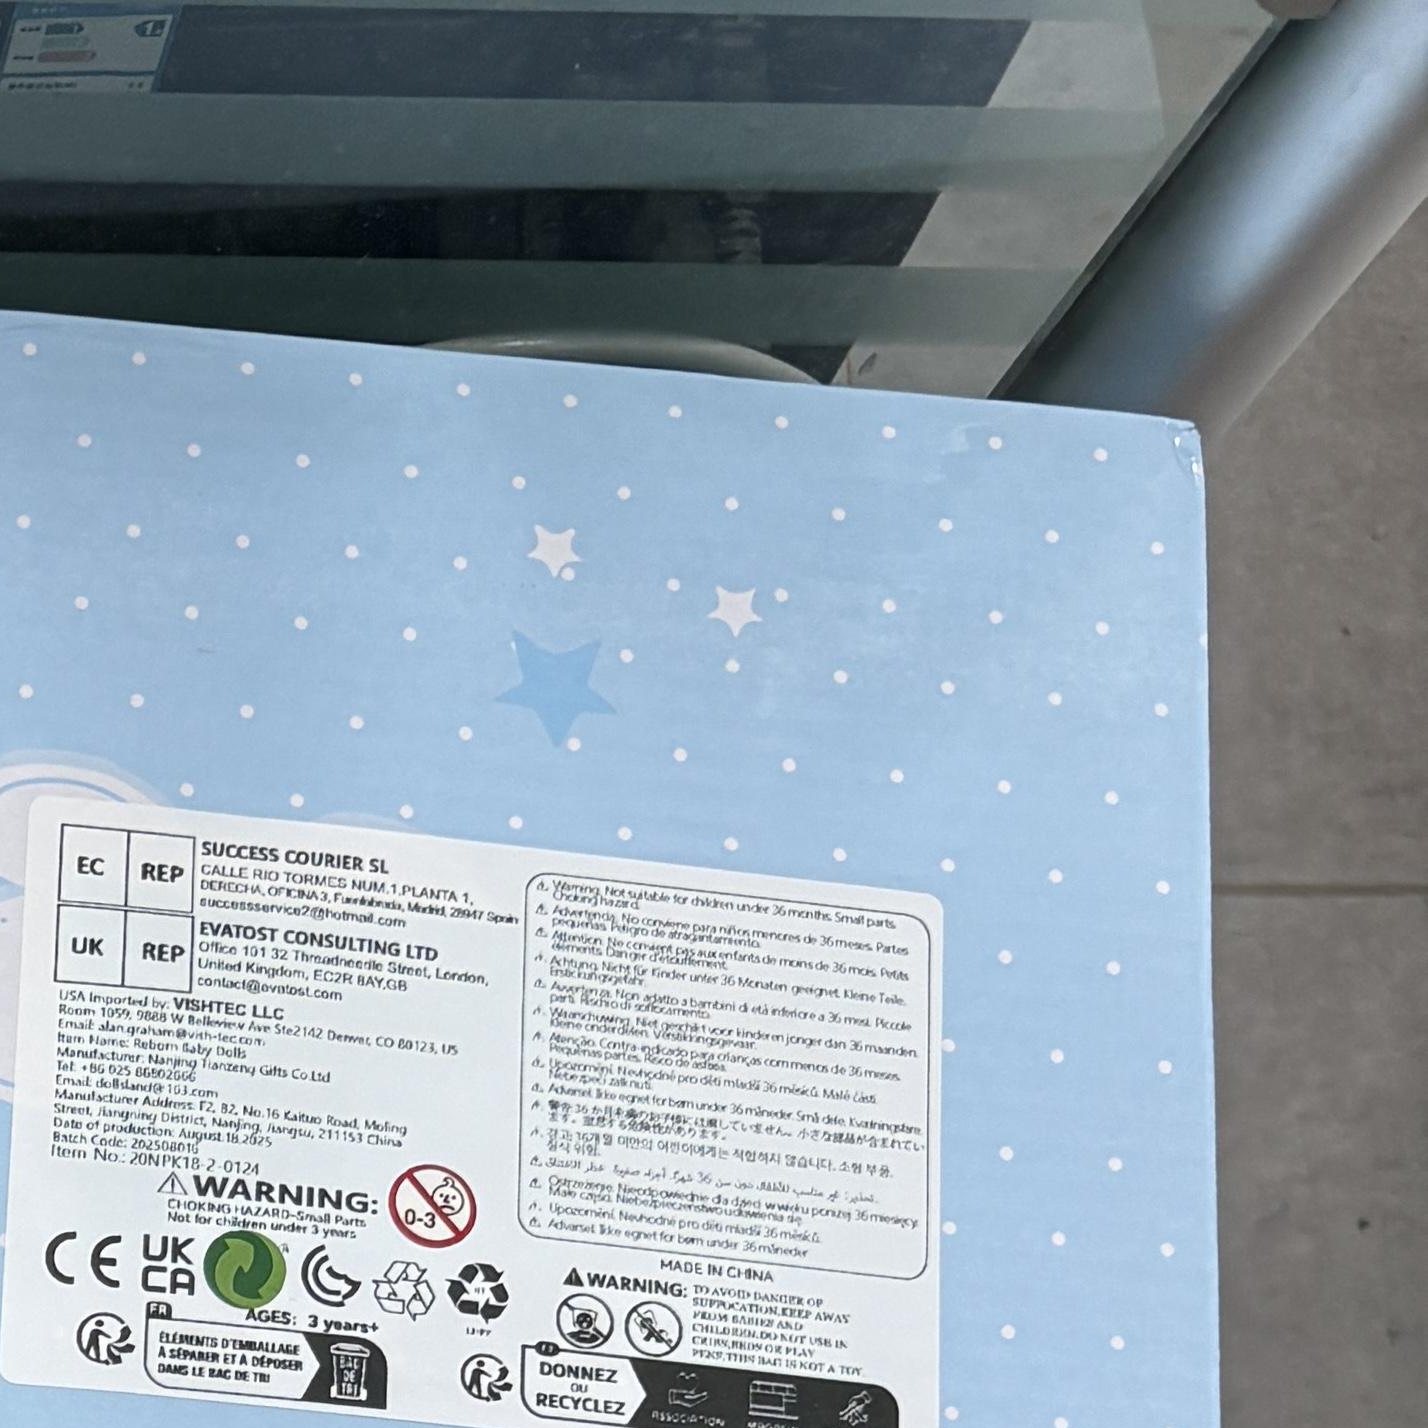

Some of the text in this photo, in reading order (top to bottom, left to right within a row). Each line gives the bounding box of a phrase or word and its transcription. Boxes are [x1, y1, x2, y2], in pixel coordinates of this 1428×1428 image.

[77, 855, 105, 876] EC
[201, 840, 389, 875] SUCCESS COURIER SL
[141, 862, 185, 883] REP
[200, 863, 348, 889] CALLE RIO TORMES
[772, 904, 787, 917] 36
[199, 921, 439, 962] EVATOST CONSULTING LTD
[621, 912, 640, 925] No
[803, 933, 818, 945] de
[820, 935, 834, 947] 36
[71, 936, 104, 957] UK
[142, 941, 186, 963] REP
[242, 945, 266, 958] 101
[271, 947, 288, 961] 32
[197, 957, 242, 973] United
[720, 974, 736, 986] 36
[59, 989, 285, 1021] USA Imported VISHTEC LLC
[58, 1003, 96, 1017] Room
[170, 1012, 185, 1025] W
[375, 1036, 395, 1049] CO
[108, 1064, 132, 1077] 025
[148, 1053, 198, 1073] Nanjing
[85, 1119, 100, 1131] of
[367, 1133, 403, 1148] China
[51, 1143, 87, 1159] Item
[93, 1147, 125, 1164] No.:
[192, 1174, 379, 1215] WARNING:
[167, 1197, 367, 1228] CHOKING Parts
[403, 1207, 436, 1228] 0-3
[167, 1211, 357, 1239] Not for children under 3 years
[44, 1231, 122, 1289] CE
[142, 1233, 195, 1266] UK
[141, 1264, 196, 1297] CA
[660, 1258, 774, 1283] MADE IN CHINA
[586, 1272, 687, 1299] WARNING:
[244, 1308, 379, 1334] AGES: 3 years+
[191, 1366, 205, 1378] LE
[234, 1369, 250, 1382] DE
[539, 1360, 618, 1384] DONNEZ
[570, 1382, 588, 1394] OU
[535, 1392, 626, 1416] RECYCLEZ
